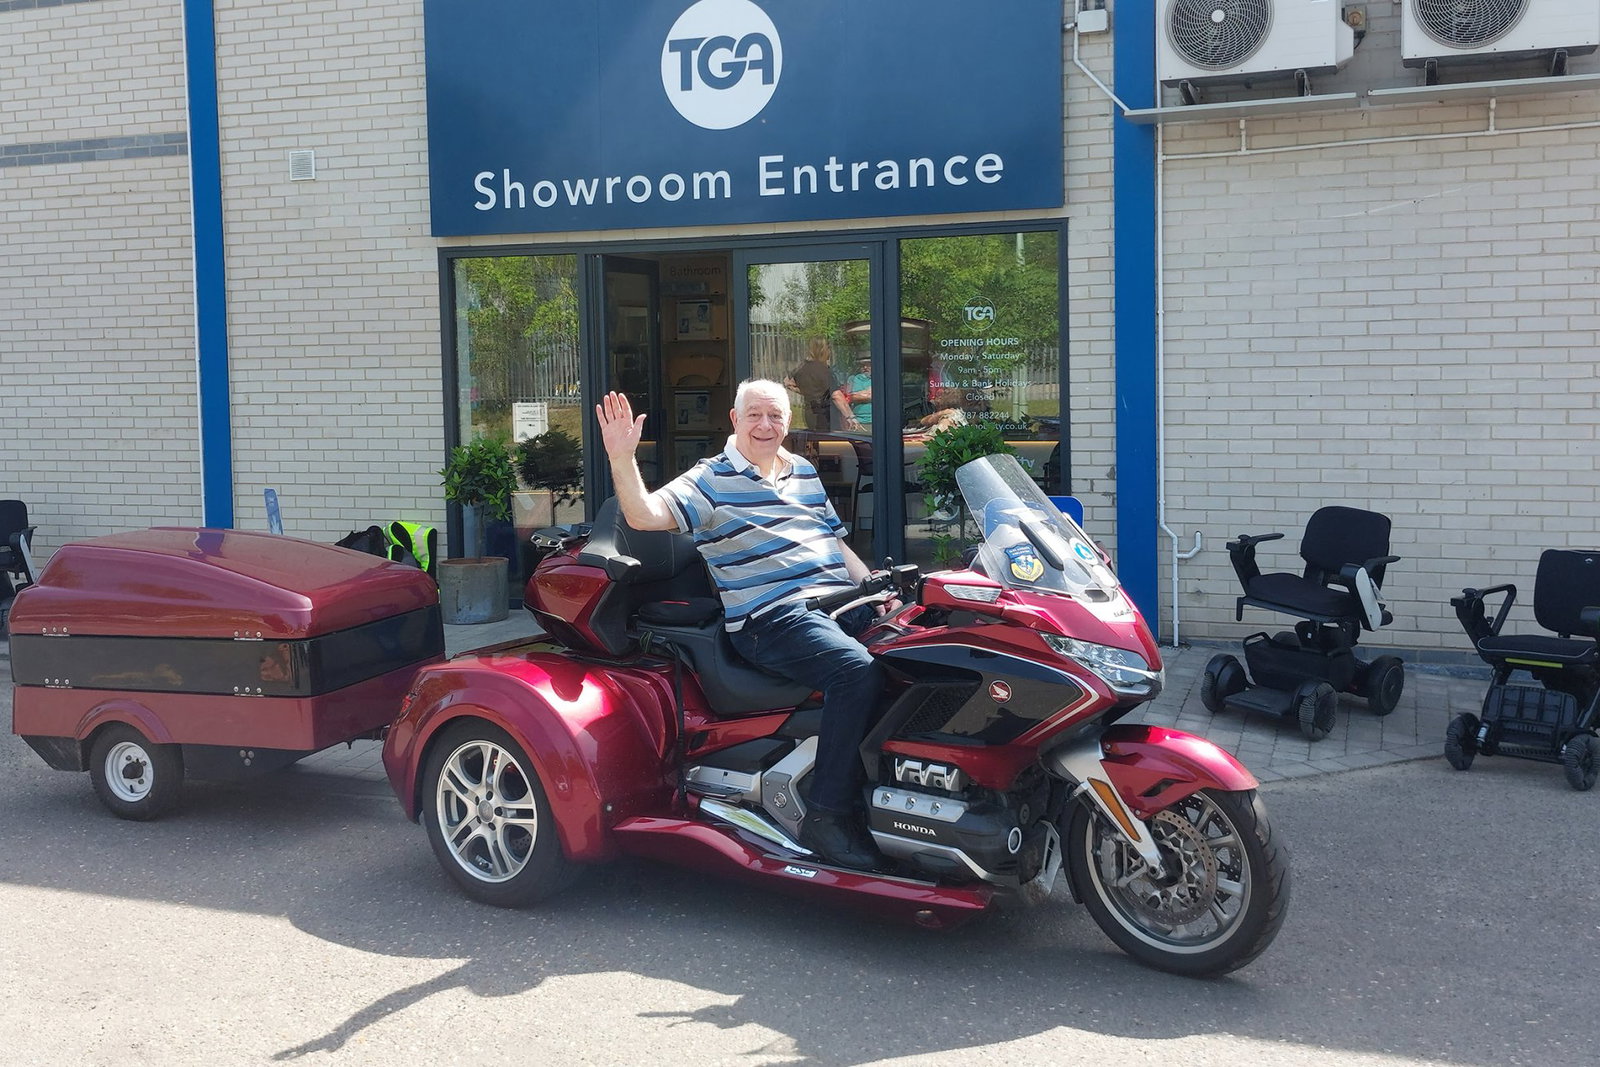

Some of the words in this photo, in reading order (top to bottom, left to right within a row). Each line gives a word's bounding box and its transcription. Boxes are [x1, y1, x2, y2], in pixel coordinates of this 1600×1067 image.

[668, 32, 775, 92] TGA
[474, 166, 732, 212] Showroom
[759, 153, 1004, 197] Entrance
[669, 265, 721, 277] Bathroom
[965, 305, 993, 321] TGA
[940, 338, 984, 347] OPENING
[986, 337, 1019, 346] HOURS
[940, 353, 973, 361] Monday
[981, 352, 1020, 361] Saturday
[958, 366, 976, 374] 9am
[983, 365, 1001, 374] 5pm
[929, 380, 960, 389] Sunday
[962, 380, 969, 388] &
[971, 379, 993, 387] Bank
[995, 379, 1032, 388] Holidays
[965, 392, 995, 401] Closed
[978, 411, 1009, 419] 882244
[893, 821, 937, 836] HONDA
